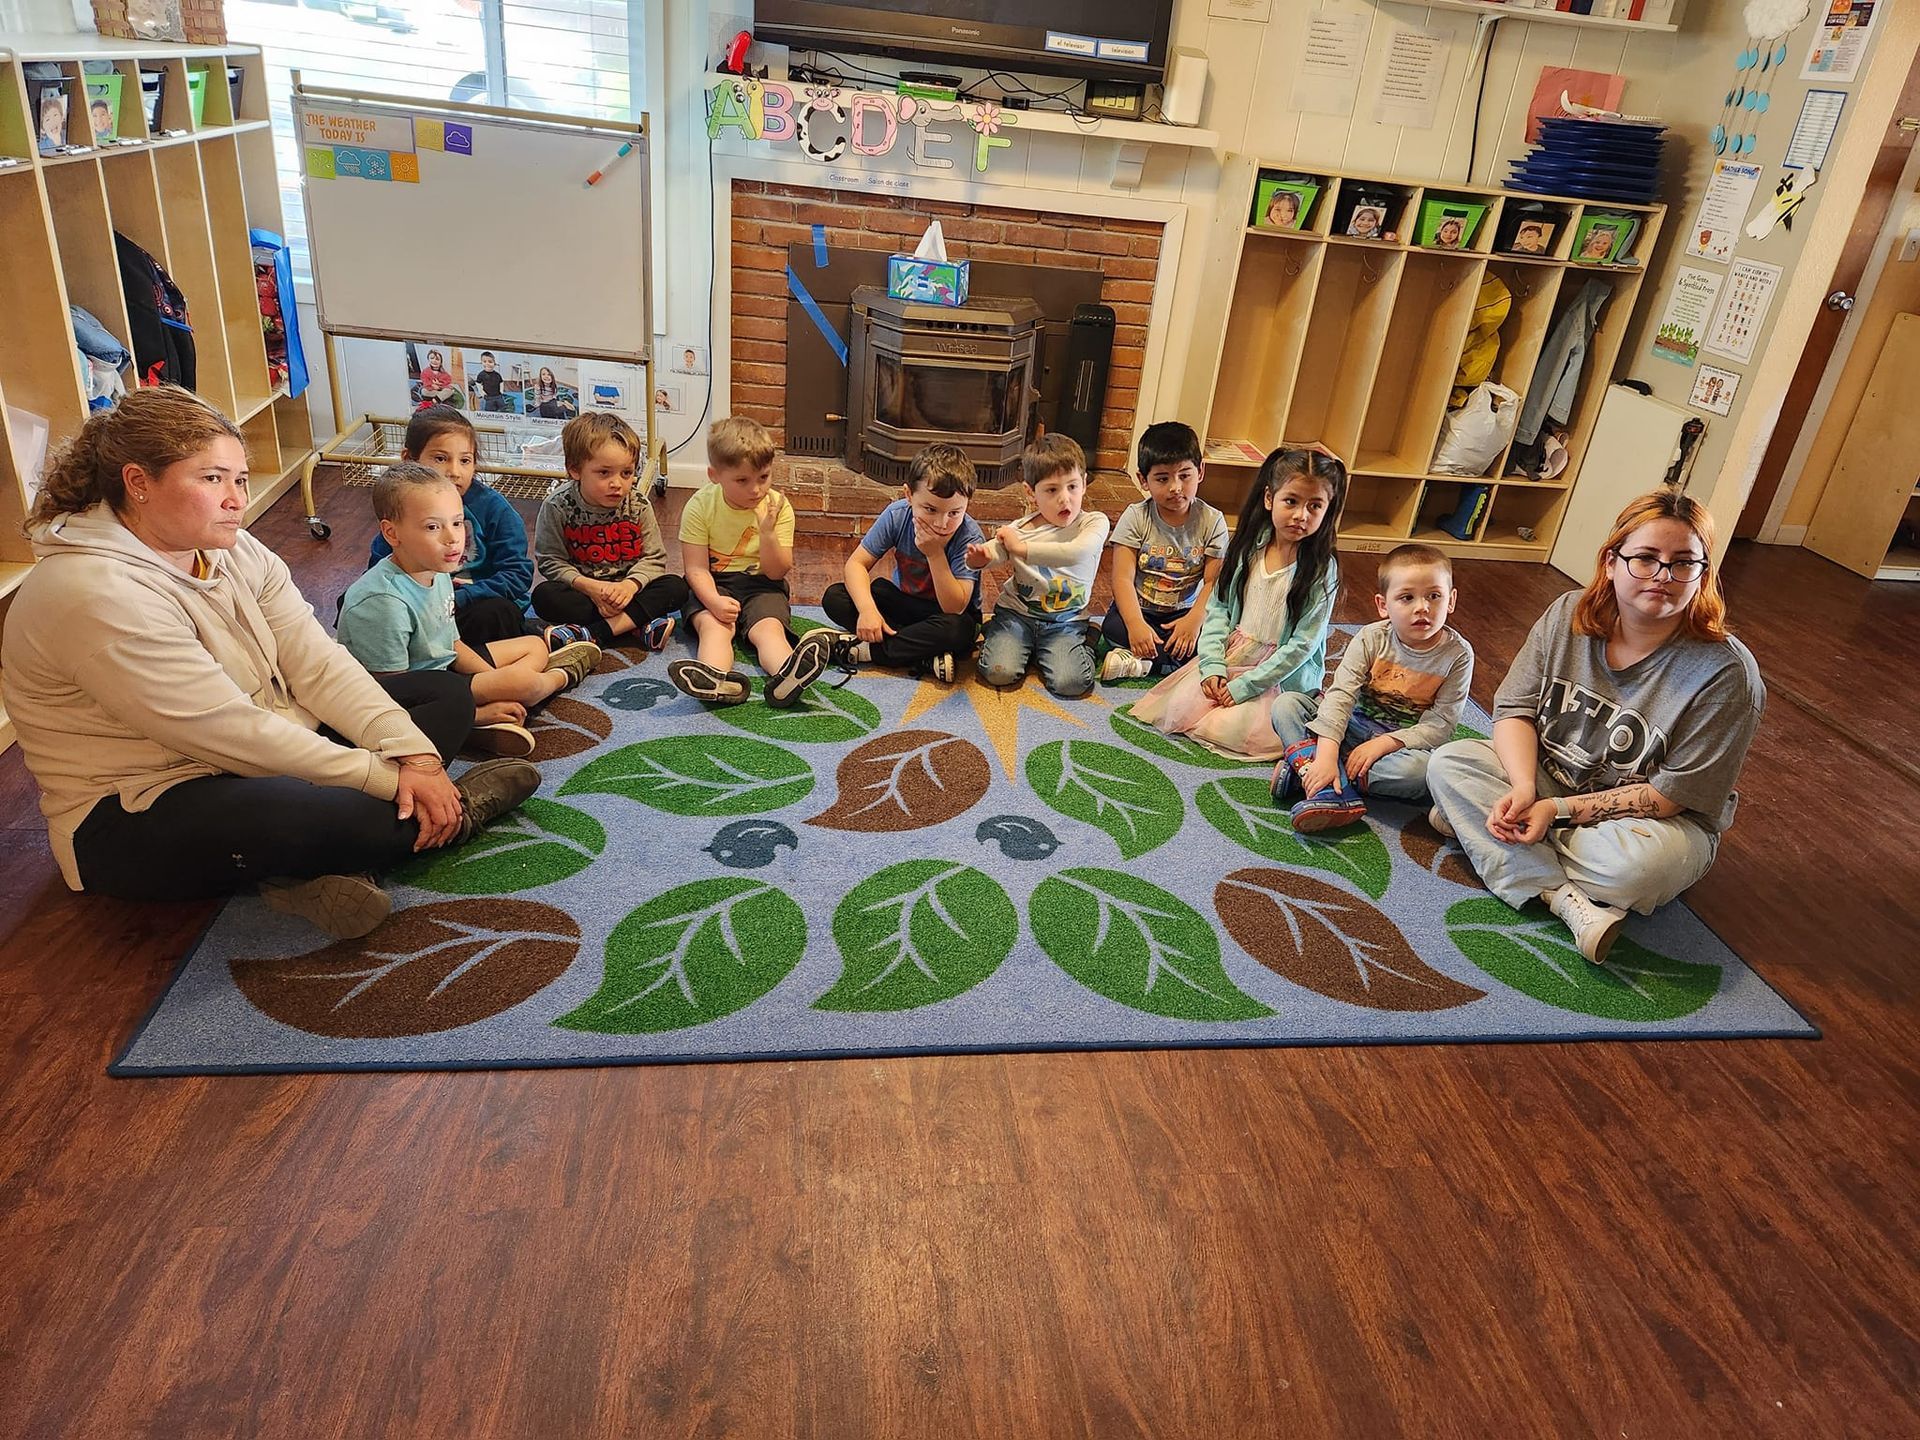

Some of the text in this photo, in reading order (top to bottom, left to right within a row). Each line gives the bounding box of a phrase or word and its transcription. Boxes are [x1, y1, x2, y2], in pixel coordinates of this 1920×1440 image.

[952, 26, 980, 36] Panasonic
[306, 114, 377, 131] THE WEATHER
[319, 127, 366, 143] TODAY IS
[829, 174, 860, 183] Classroom
[563, 522, 642, 544] MICKEY
[567, 540, 643, 563] MOUSE
